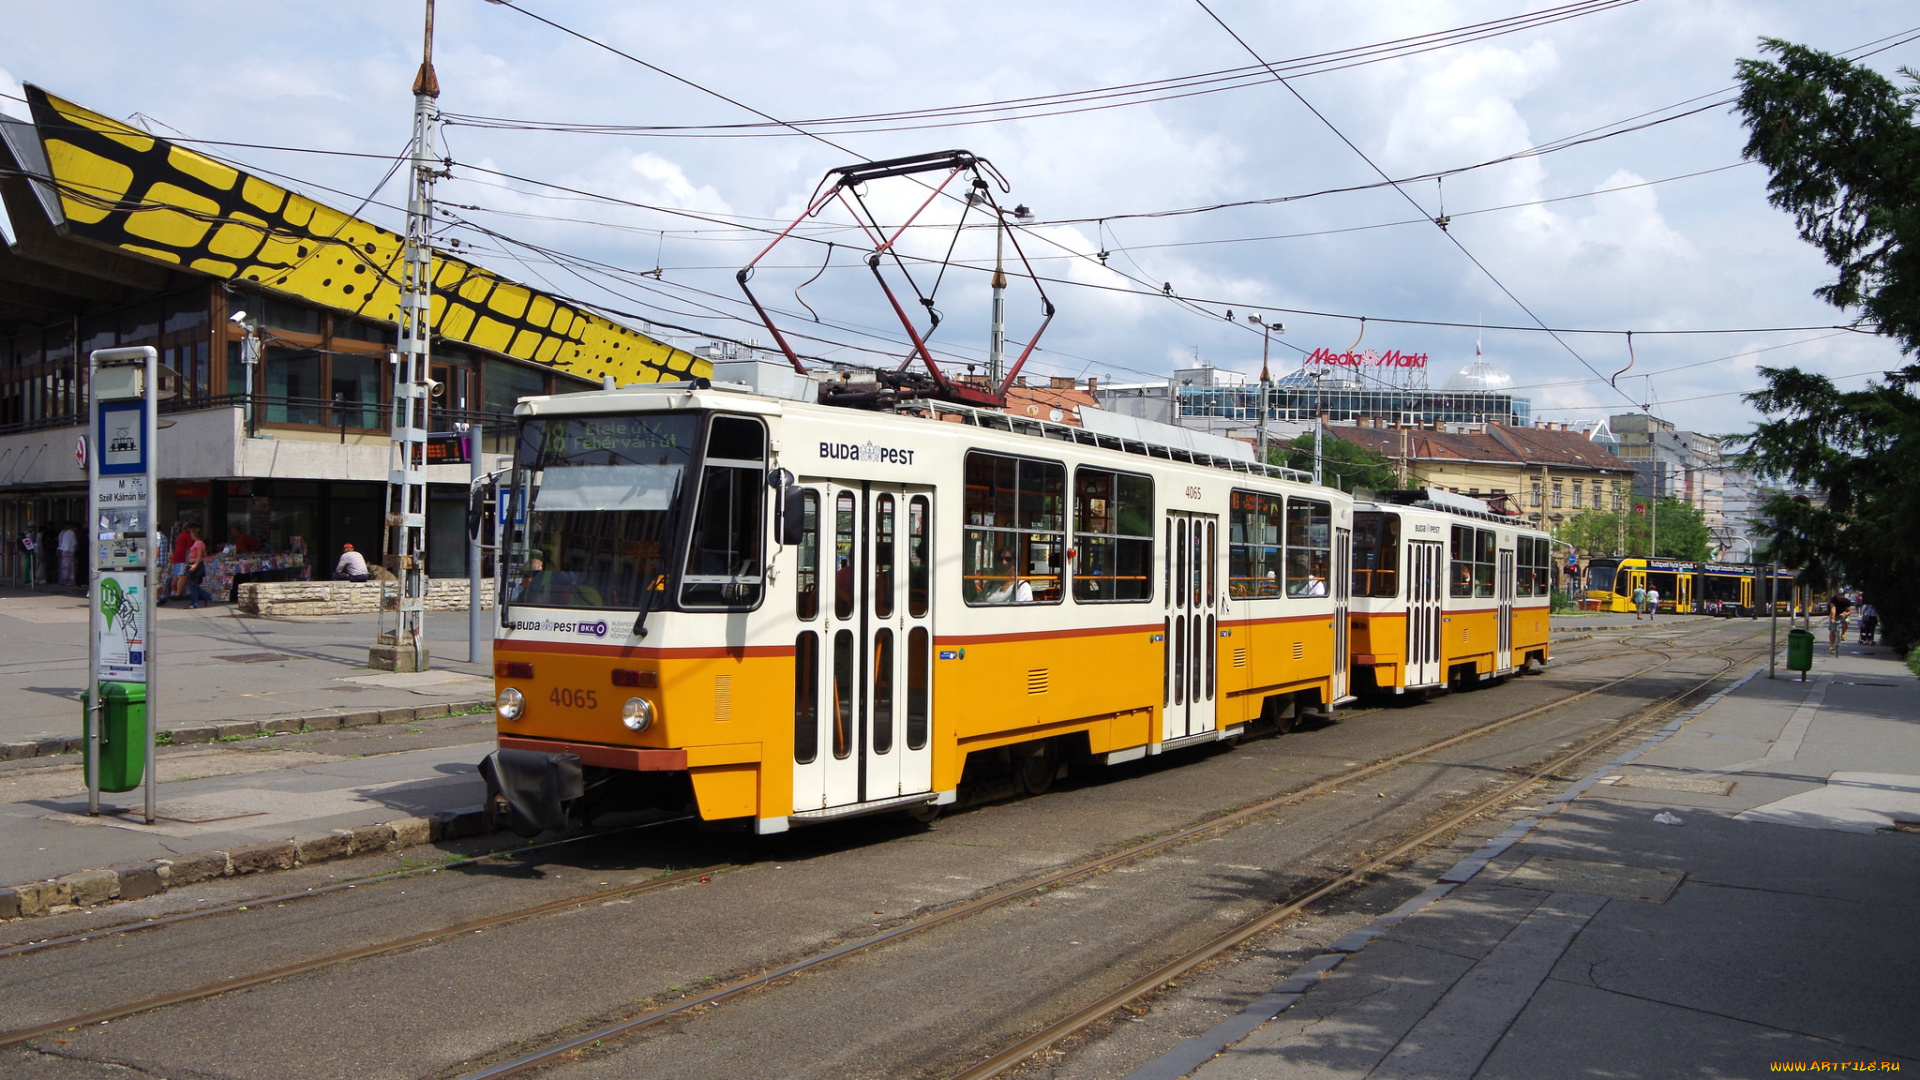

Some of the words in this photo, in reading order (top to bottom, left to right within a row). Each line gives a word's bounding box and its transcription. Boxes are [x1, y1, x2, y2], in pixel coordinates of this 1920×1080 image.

[1305, 348, 1362, 366] Media
[1376, 349, 1428, 368] Markt
[586, 421, 626, 436] Etele
[573, 434, 656, 451] Fehérvári
[659, 433, 677, 448] út
[119, 480, 126, 489] M
[99, 494, 113, 502] Széll
[114, 492, 137, 502] Kálmán
[1185, 486, 1202, 500] 4065
[580, 624, 594, 632] BKK
[550, 687, 598, 709] 4065
